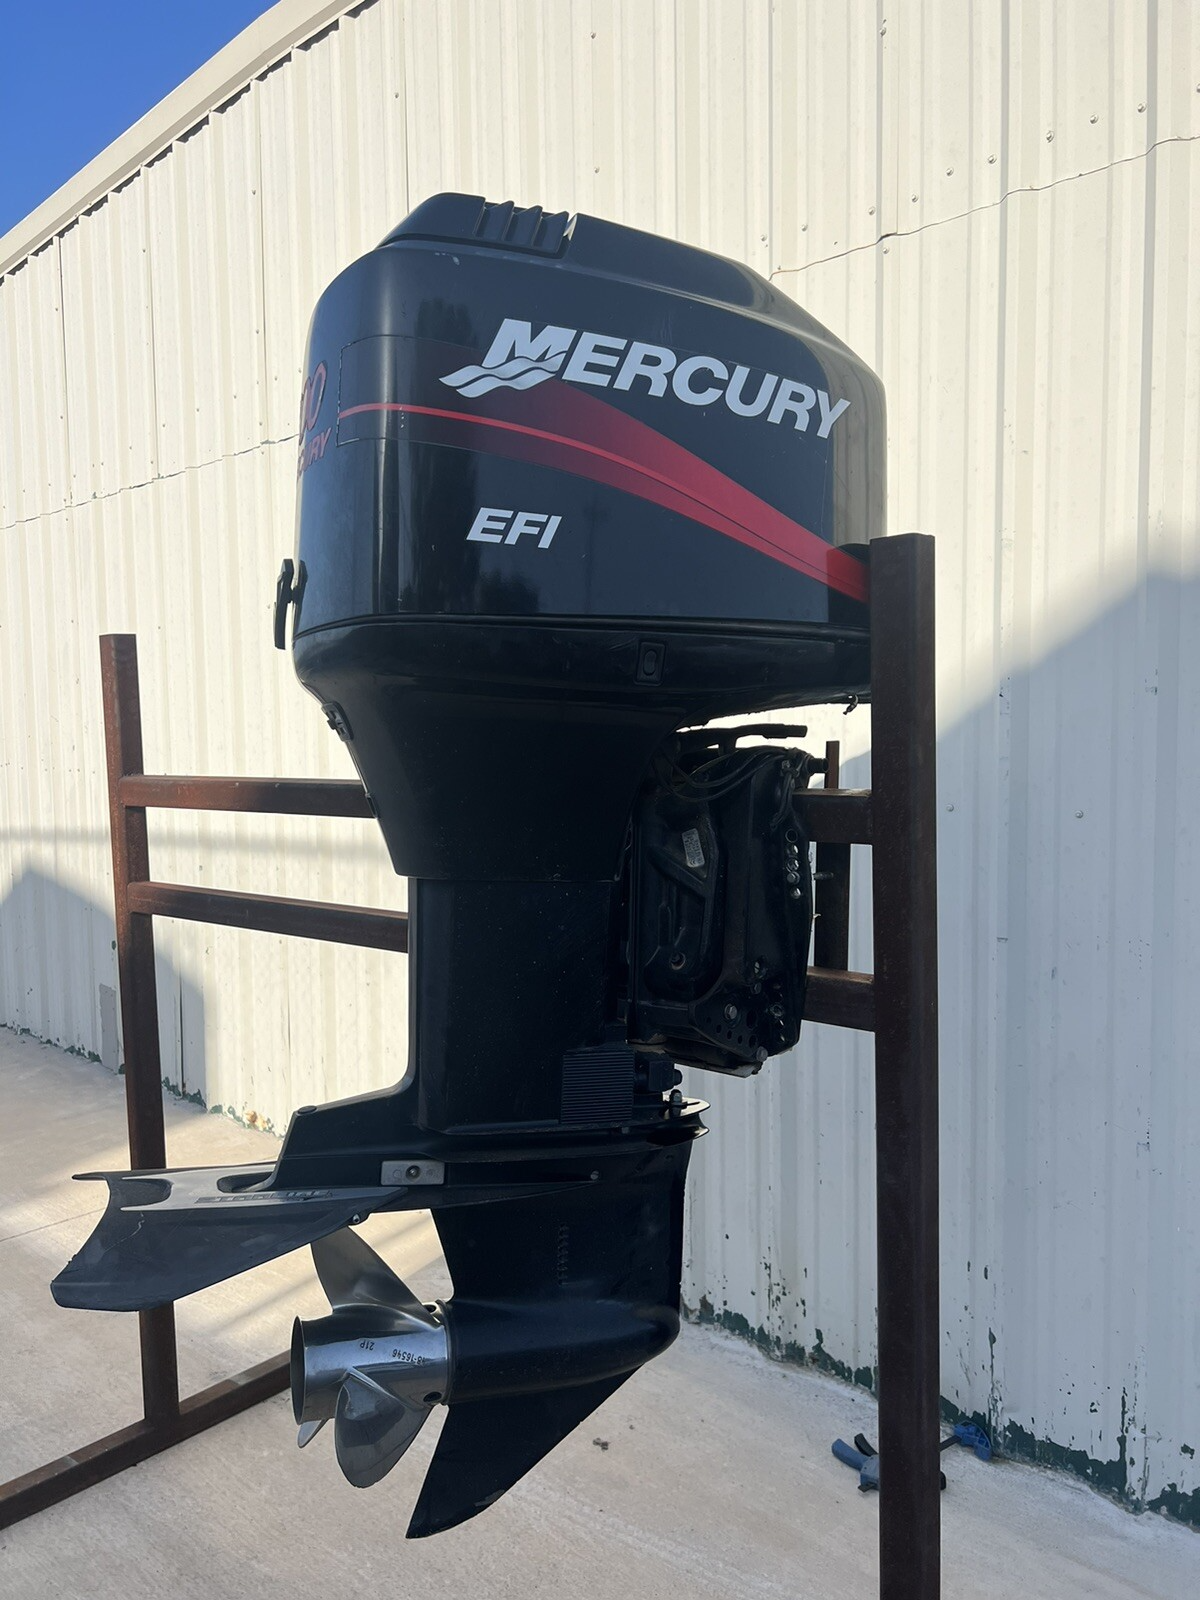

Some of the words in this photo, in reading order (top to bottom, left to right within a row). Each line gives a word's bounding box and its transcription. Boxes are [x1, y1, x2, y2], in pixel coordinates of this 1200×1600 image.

[439, 318, 851, 439] MERCURY
[466, 507, 562, 549] EFI
[359, 1340, 375, 1351] 21P
